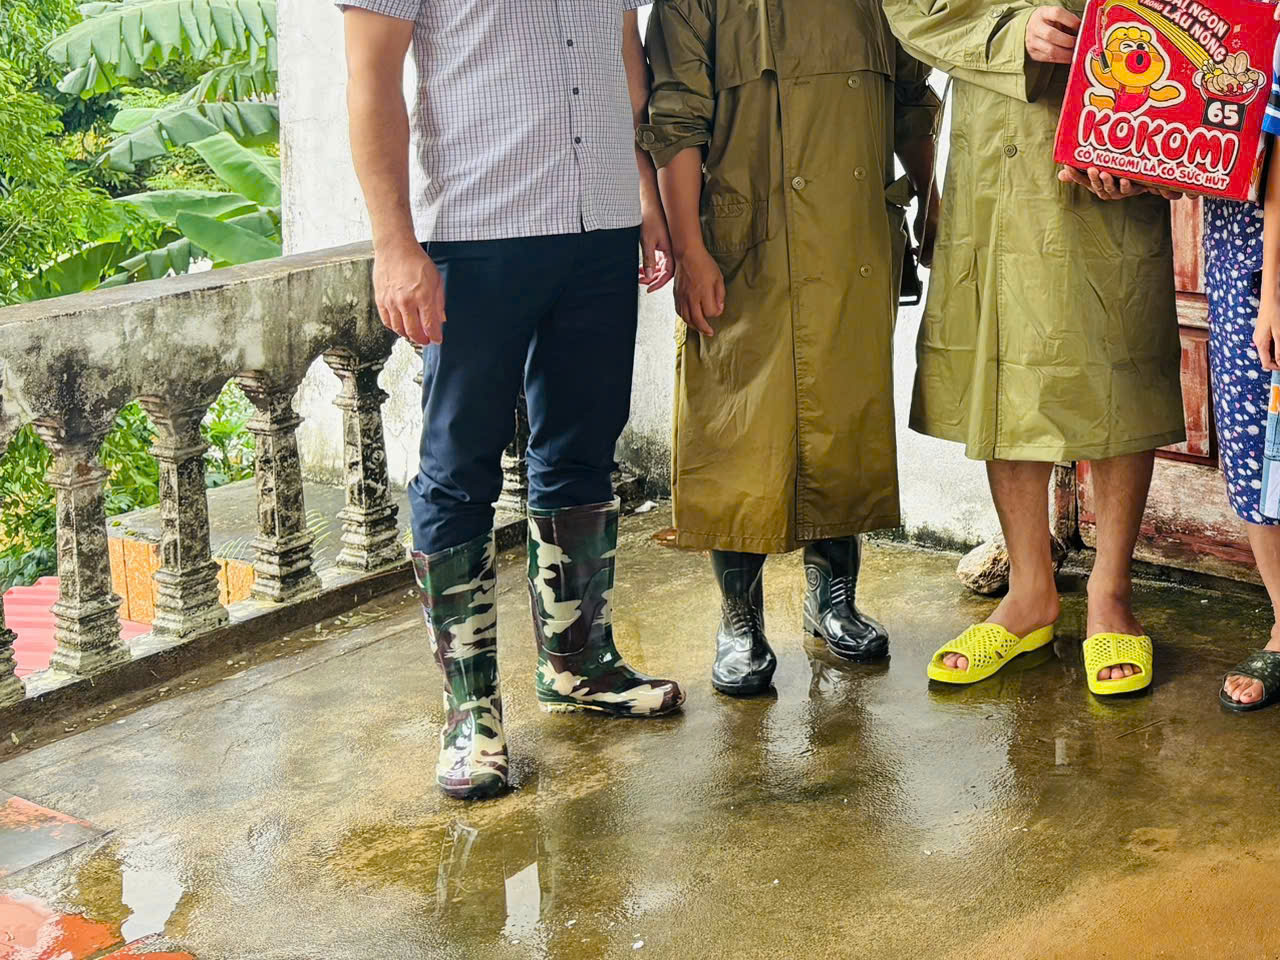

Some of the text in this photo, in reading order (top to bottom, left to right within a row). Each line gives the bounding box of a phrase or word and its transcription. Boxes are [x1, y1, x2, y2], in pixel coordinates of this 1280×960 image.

[1188, 1, 1229, 38] NGON
[1190, 23, 1226, 61] NÓNG
[1207, 101, 1240, 127] 65
[1080, 108, 1238, 174] KOKOMI
[1096, 152, 1140, 171] KOKOMI
